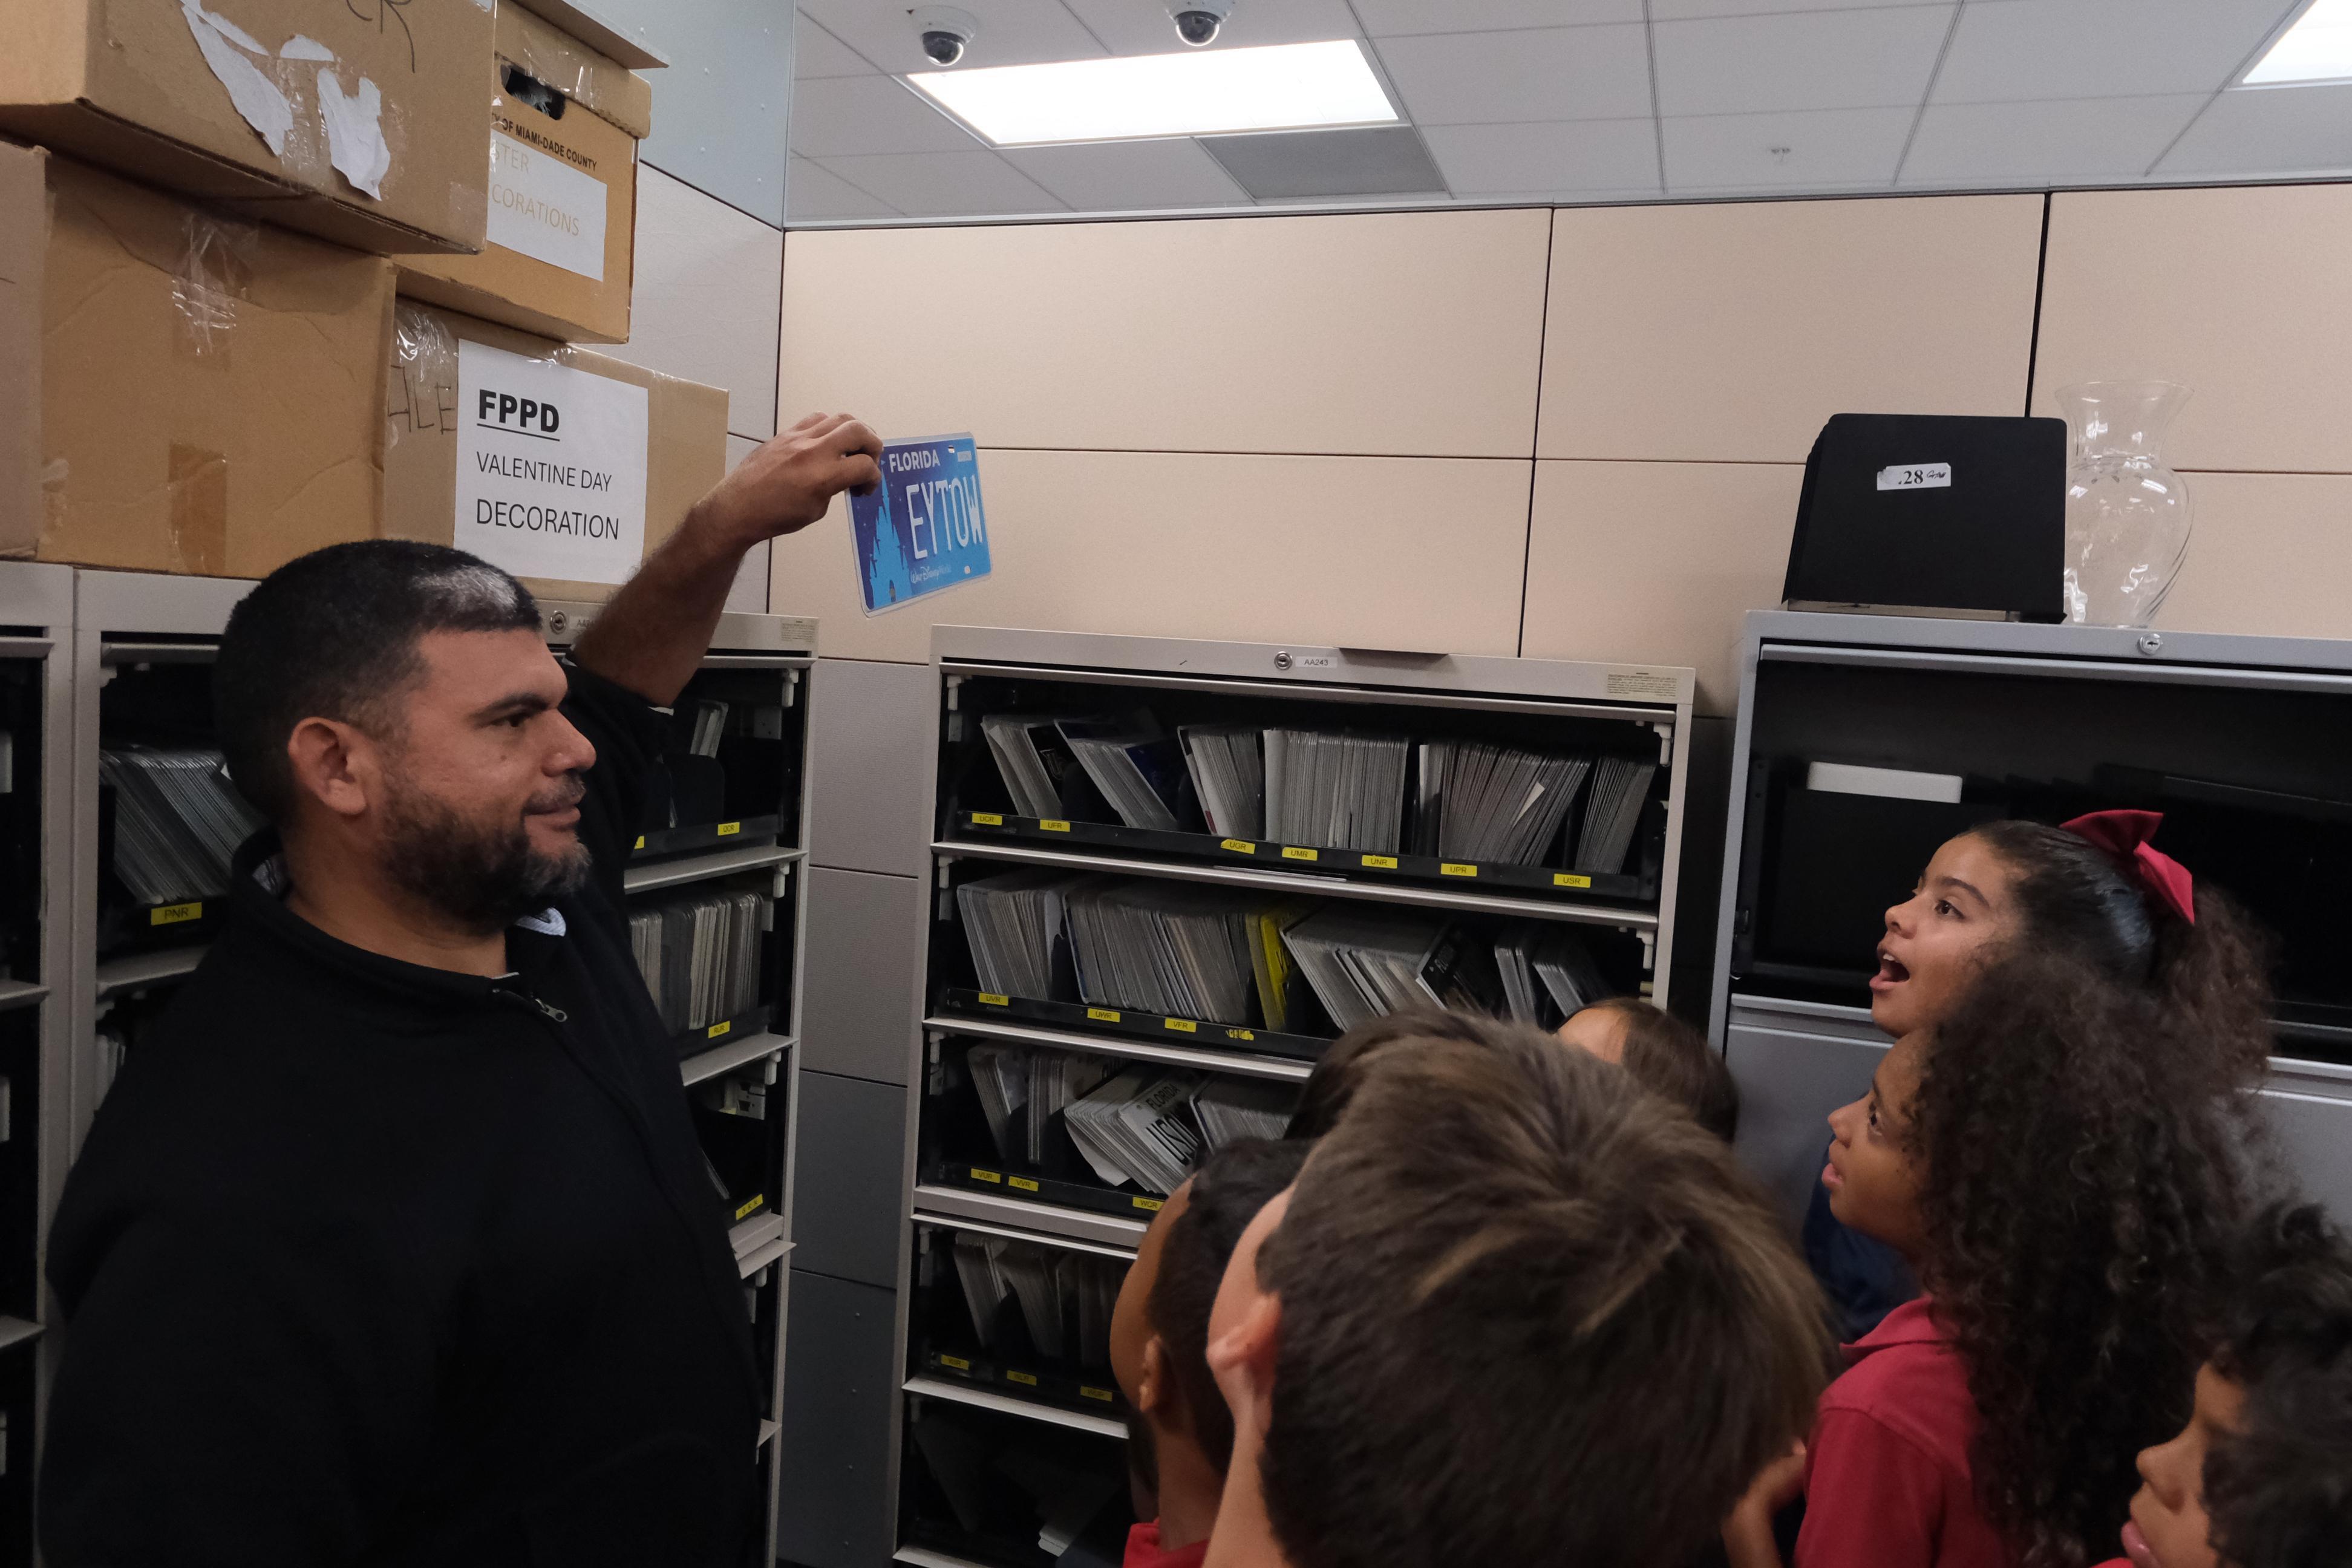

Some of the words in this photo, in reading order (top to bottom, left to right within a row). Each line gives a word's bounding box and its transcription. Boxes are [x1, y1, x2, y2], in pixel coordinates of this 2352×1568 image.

[502, 118, 513, 132] OF
[516, 124, 564, 157] MIAMI-DADE
[566, 148, 597, 171] COUNTY
[479, 389, 560, 434] FPPD
[476, 451, 576, 487] VALENTINE
[581, 469, 612, 492] DAY
[889, 449, 941, 473] FLORIDA
[476, 498, 619, 540] DECORATION
[906, 474, 983, 560] EYTOW
[1370, 858, 1388, 867] UNR
[1563, 877, 1581, 885] USR
[164, 907, 189, 920] PNR
[1173, 1021, 1188, 1030] VFR
[1145, 1083, 1181, 1111] FLORIDA
